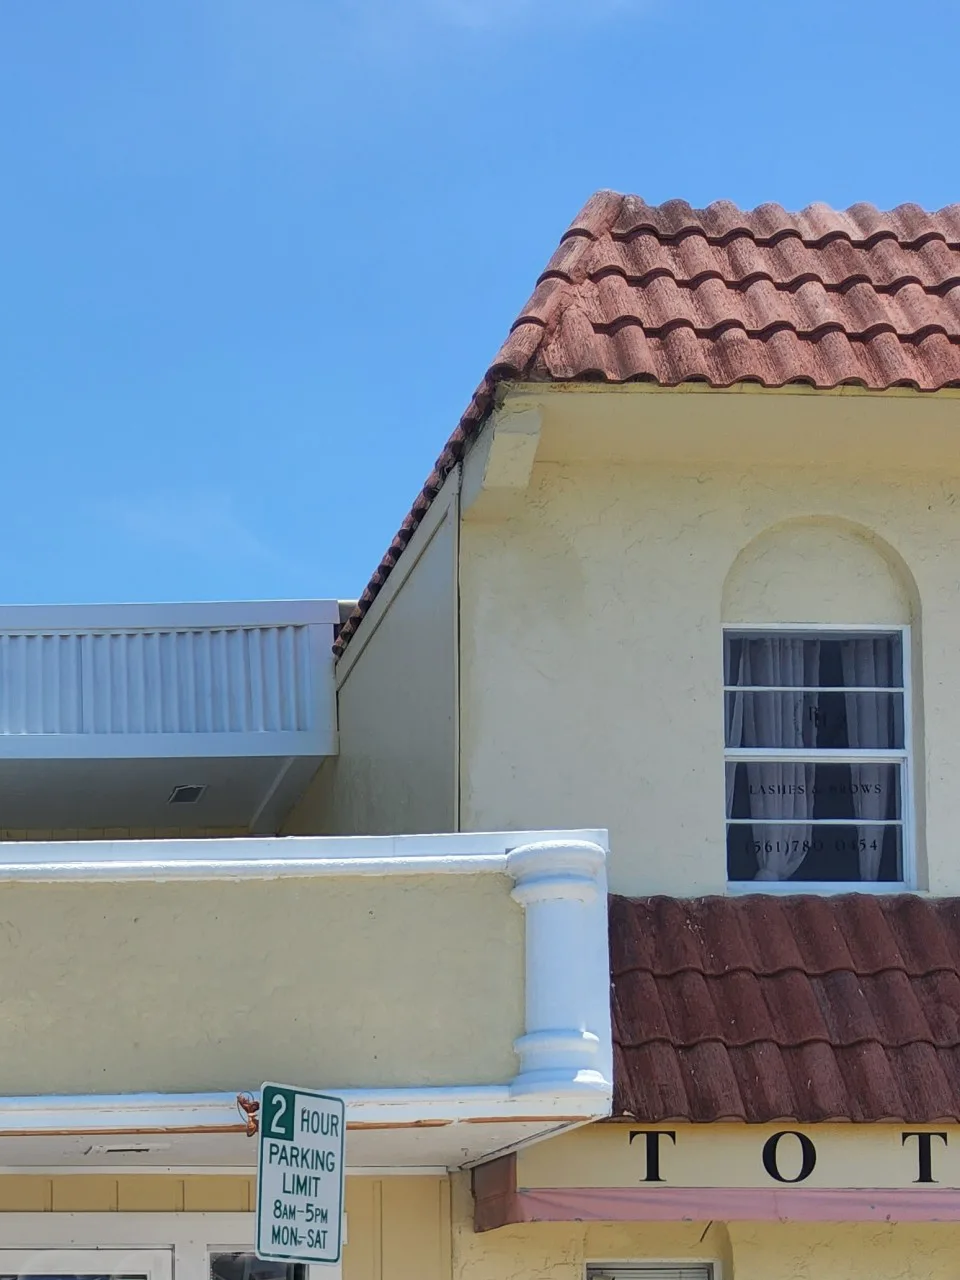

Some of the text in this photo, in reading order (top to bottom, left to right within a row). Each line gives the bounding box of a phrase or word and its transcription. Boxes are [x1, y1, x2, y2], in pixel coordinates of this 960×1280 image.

[749, 784, 805, 795] LASHES
[270, 1093, 339, 1137] 2 HOUR
[268, 1143, 335, 1172] PARKING
[282, 1172, 321, 1197] LIMIT
